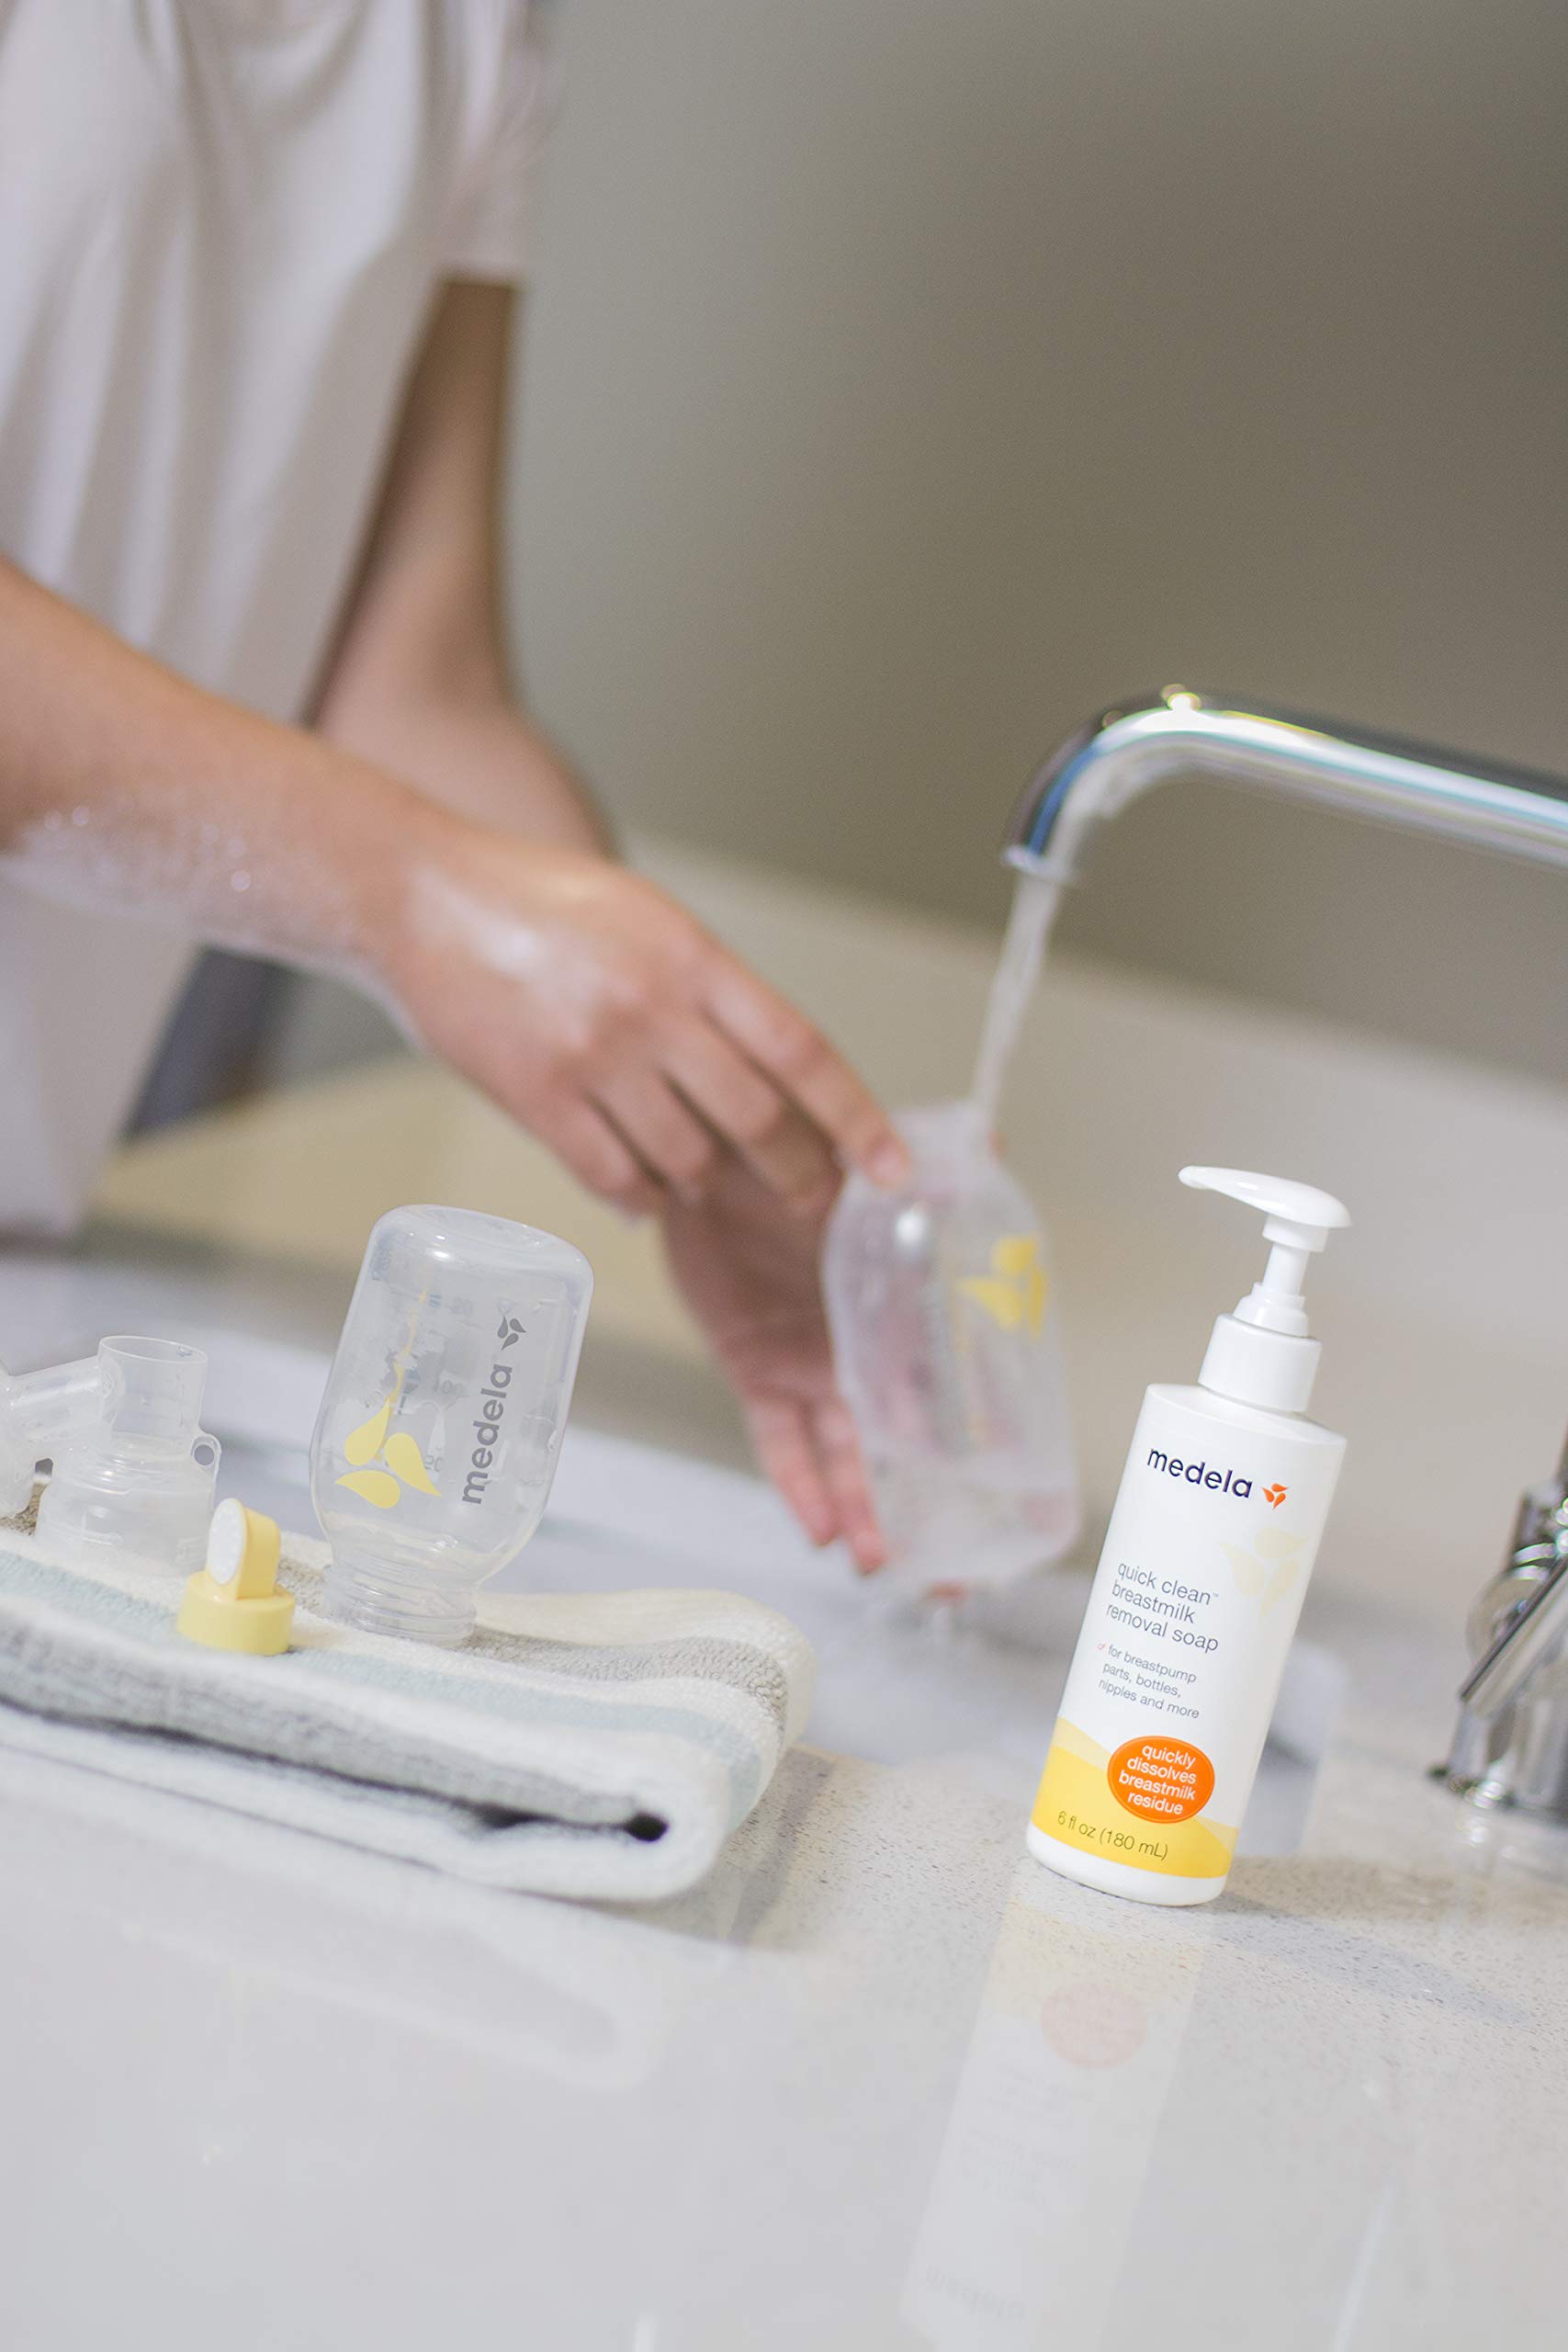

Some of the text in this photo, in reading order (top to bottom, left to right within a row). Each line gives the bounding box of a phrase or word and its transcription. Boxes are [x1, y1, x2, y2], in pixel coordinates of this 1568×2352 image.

[462, 1363, 513, 1505] medela
[1147, 1449, 1253, 1498] medela
[1118, 1562, 1157, 1589] quick
[1111, 1579, 1196, 1623] breastmilk
[1106, 1603, 1219, 1653] removal soap
[1102, 1663, 1181, 1698] parts, bottles,
[1108, 1644, 1197, 1684] for breastpump
[1099, 1679, 1200, 1719] nipples and more
[1127, 1757, 1197, 1784] dissolves
[1142, 1745, 1196, 1770] quickly
[1119, 1770, 1196, 1801] breastmilk
[1127, 1792, 1183, 1815] residue
[1057, 1811, 1168, 1861] 6 fl oz (180 mL)
